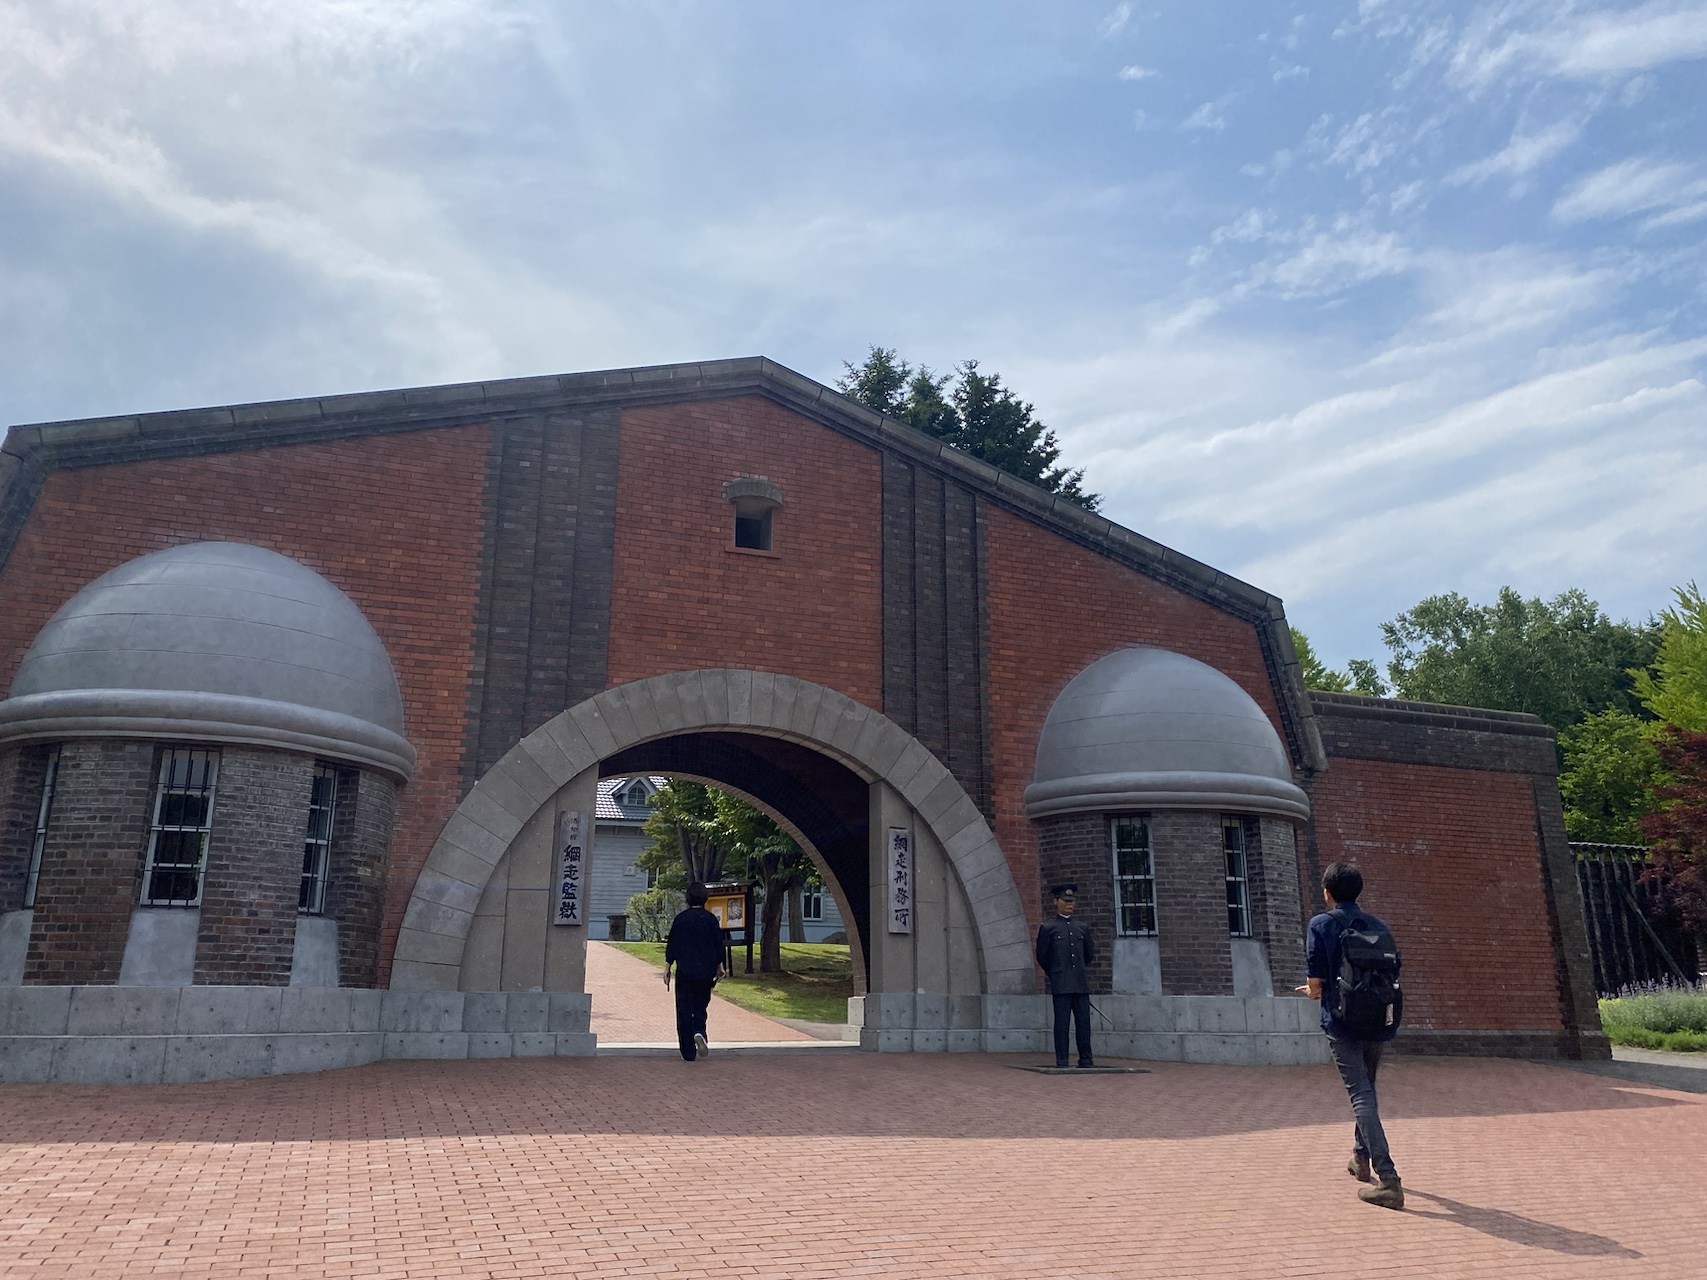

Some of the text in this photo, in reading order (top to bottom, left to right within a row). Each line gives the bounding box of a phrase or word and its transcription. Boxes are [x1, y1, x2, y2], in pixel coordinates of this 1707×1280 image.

[559, 844, 581, 920] 網走監獄
[893, 834, 909, 926] 網走刑務所
